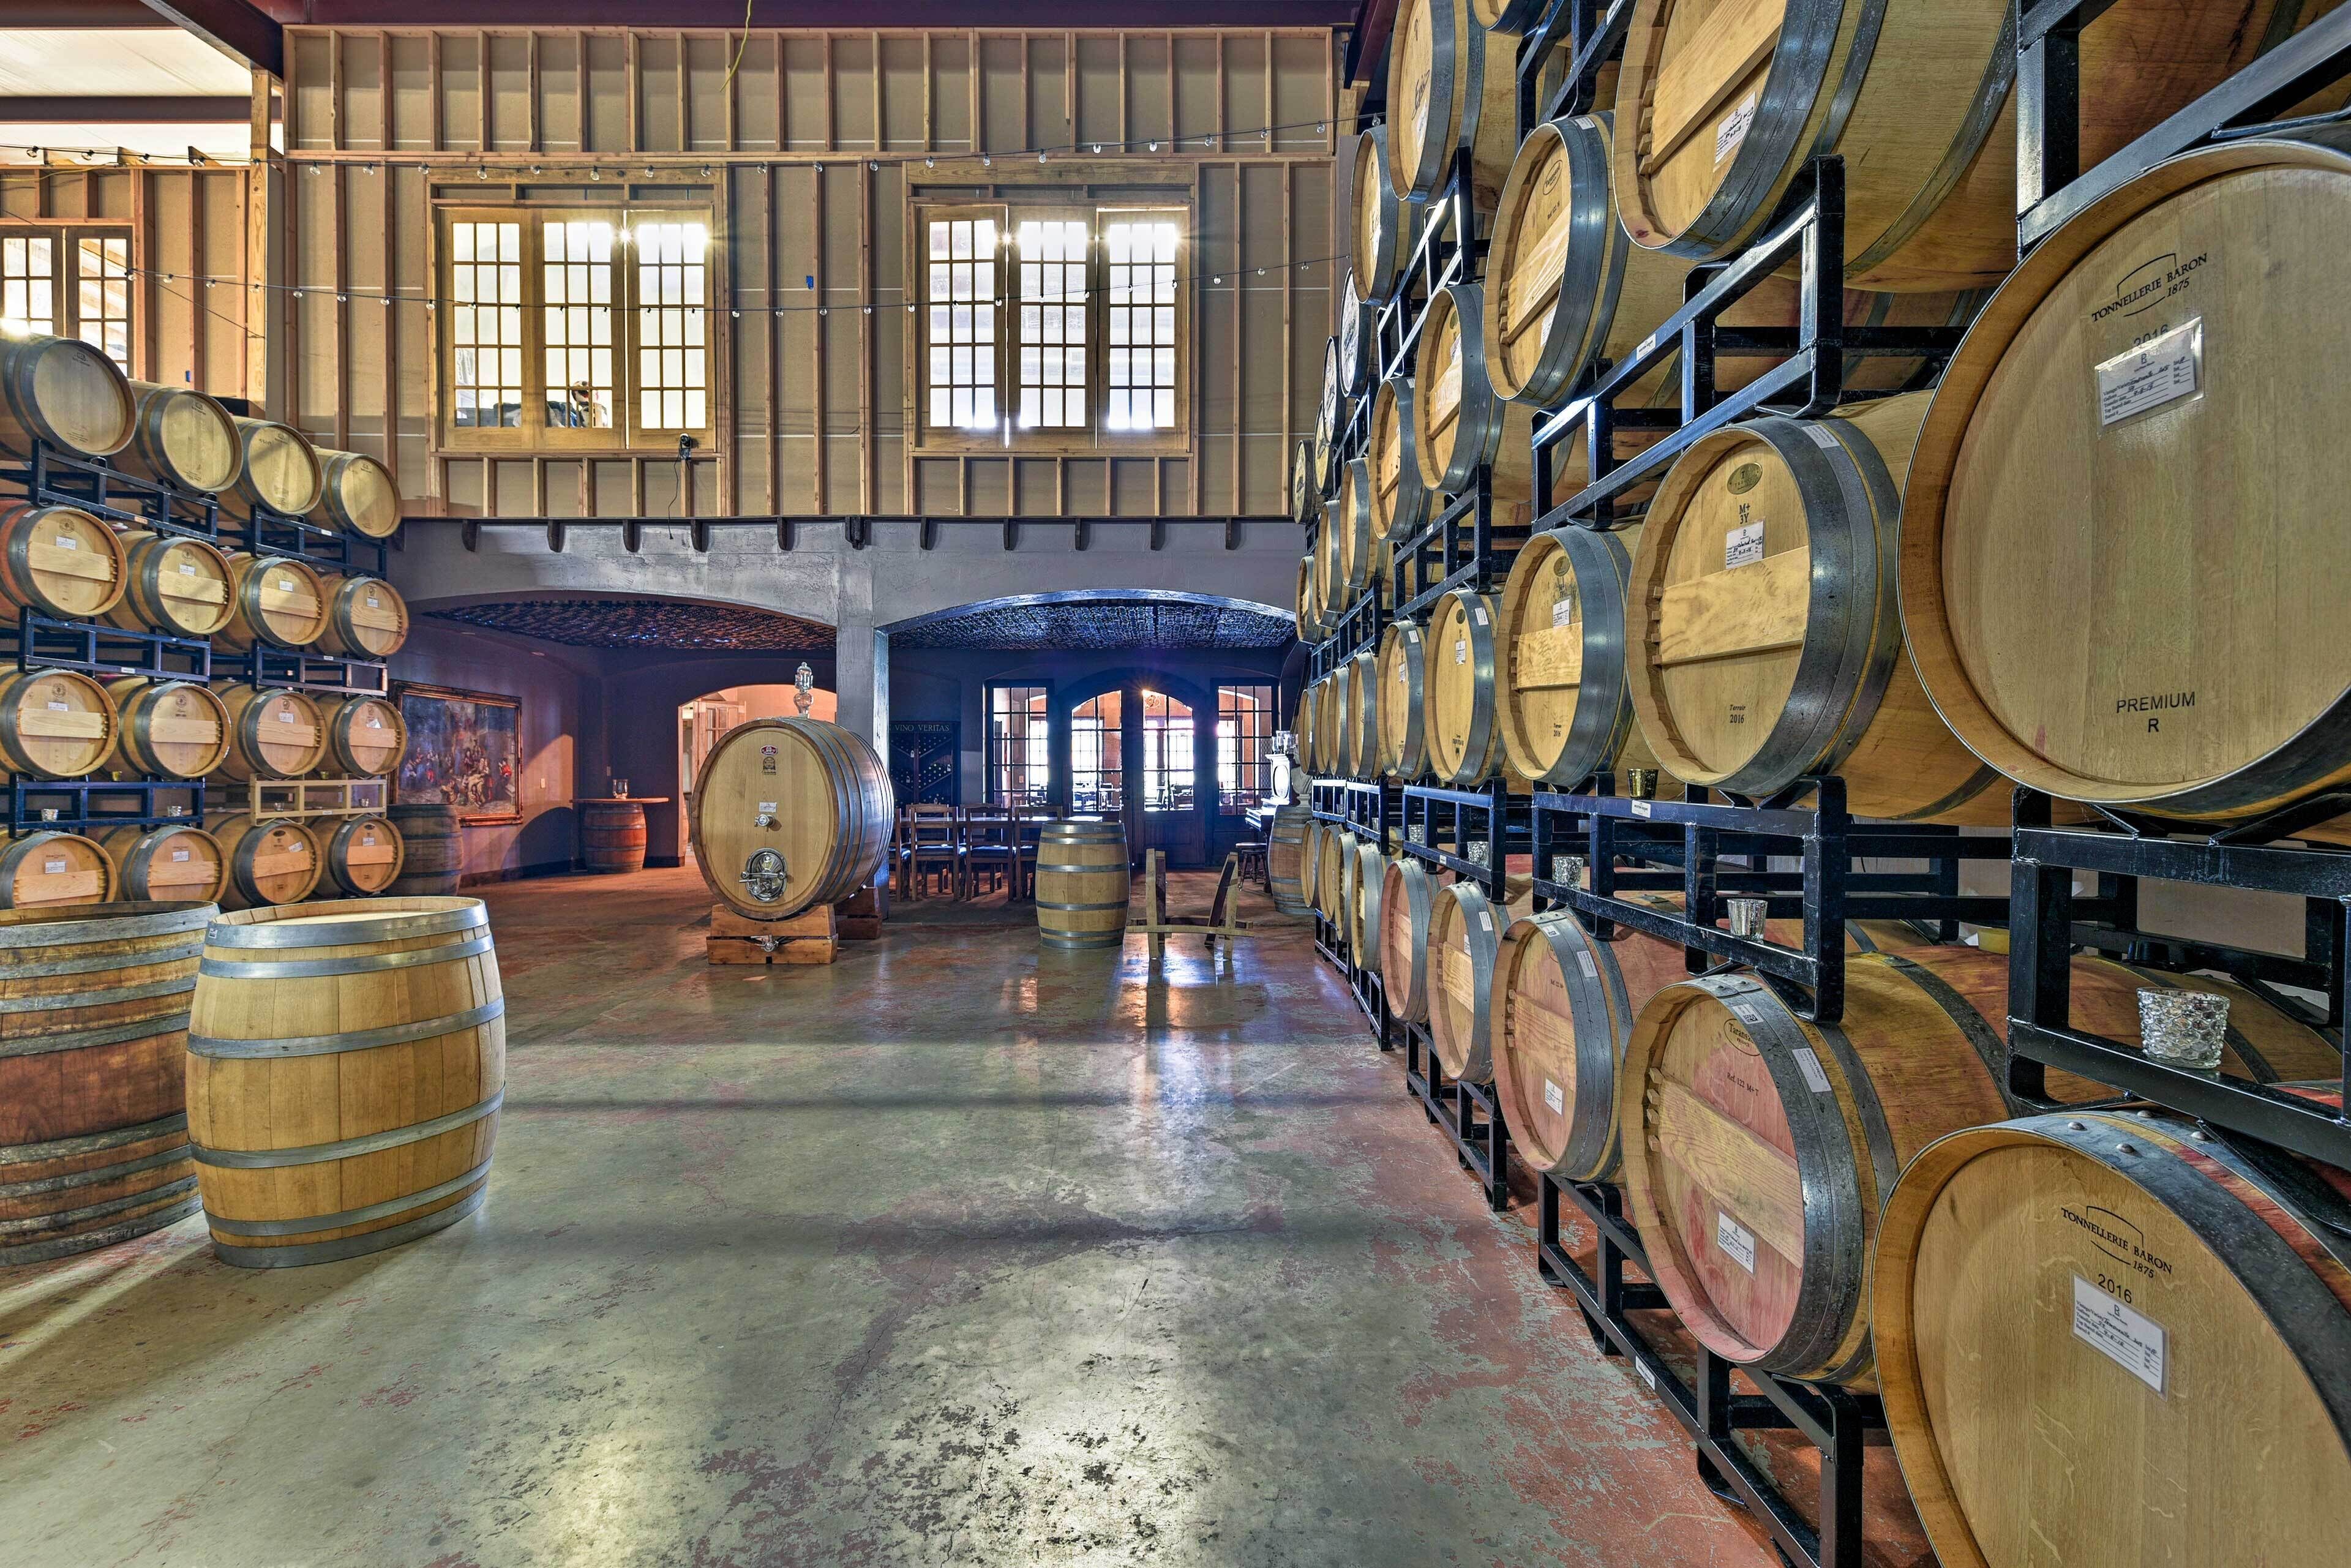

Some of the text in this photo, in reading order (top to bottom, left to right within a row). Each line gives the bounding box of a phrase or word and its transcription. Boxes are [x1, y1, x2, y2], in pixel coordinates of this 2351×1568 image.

[2092, 253, 2207, 323] TONNELLERIE BARON
[2166, 278, 2190, 298] 1875
[1739, 503, 1750, 514] M+
[1740, 513, 1749, 524] 3Y
[2117, 691, 2195, 713] PREMIUM
[1730, 714, 1745, 724] 2016
[2148, 718, 2159, 732] R
[1729, 1023, 1754, 1044] Taransa
[2061, 1207, 2172, 1274] TONNELLERIE BARON
[2132, 1261, 2154, 1278] 1875
[2098, 1274, 2132, 1304] 2016
